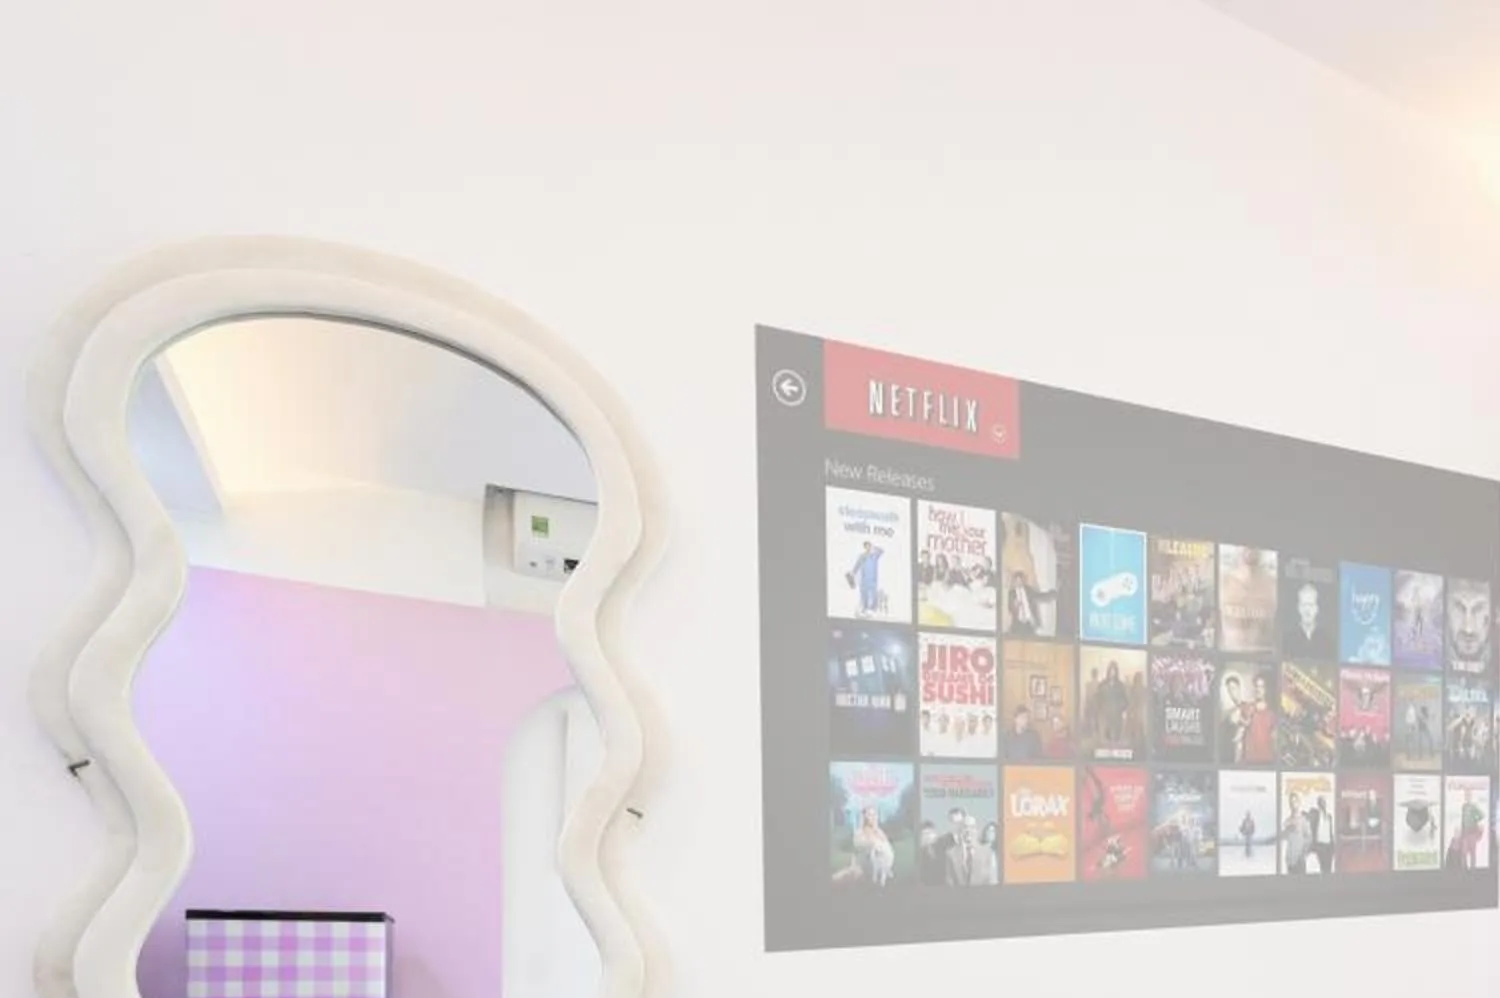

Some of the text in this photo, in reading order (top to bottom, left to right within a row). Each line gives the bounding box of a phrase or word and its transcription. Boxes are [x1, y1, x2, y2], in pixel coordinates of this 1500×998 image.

[868, 379, 978, 433] NETFLIX
[824, 457, 936, 491] New Releases
[922, 643, 995, 675] JIRO
[922, 682, 995, 707] SUSHI
